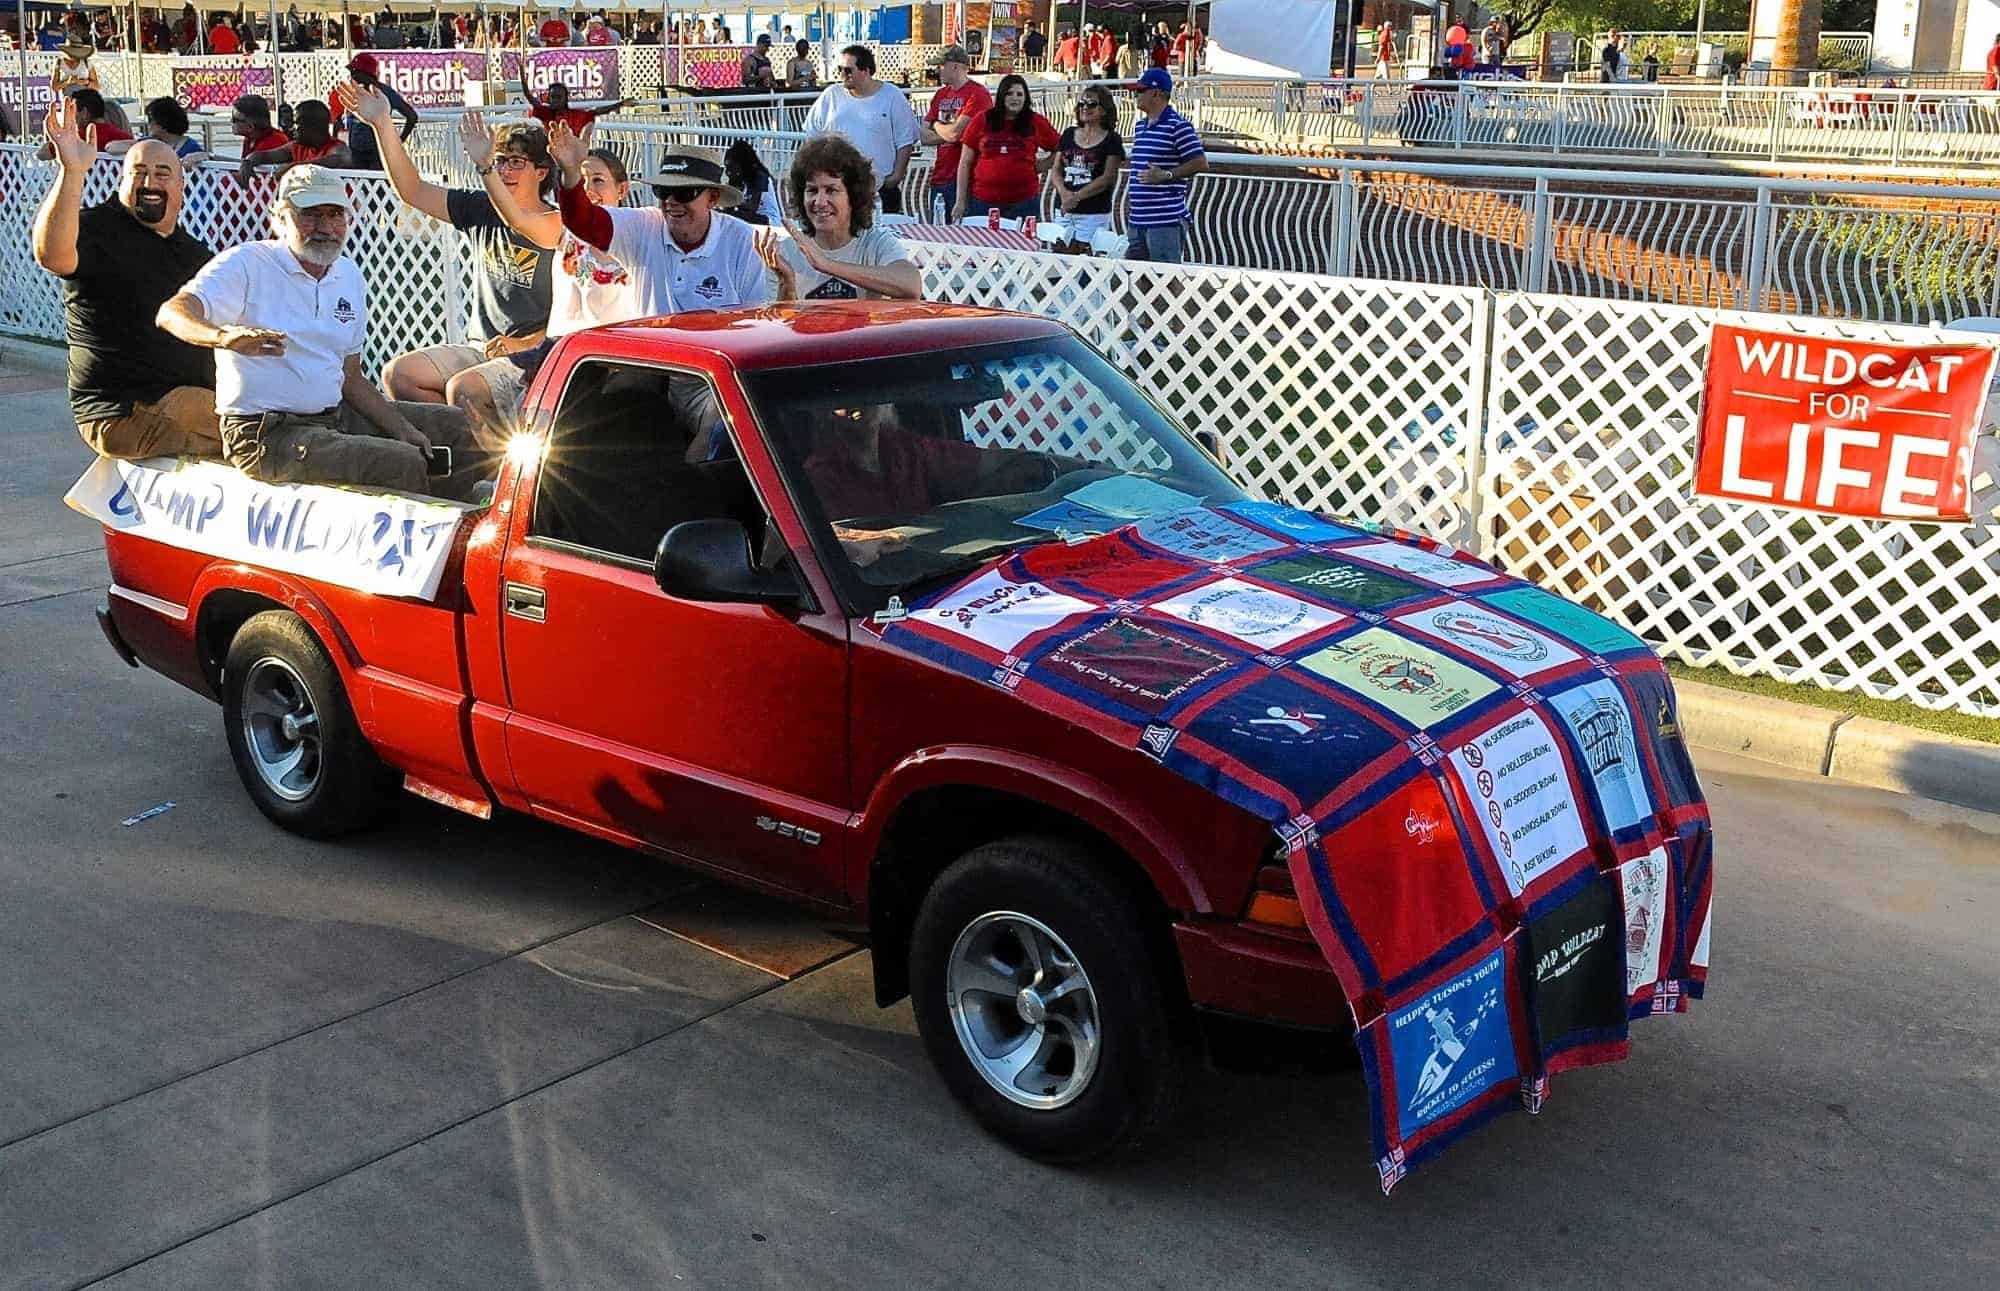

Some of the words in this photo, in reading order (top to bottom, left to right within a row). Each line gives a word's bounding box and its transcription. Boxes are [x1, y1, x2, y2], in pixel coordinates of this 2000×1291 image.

[826, 283, 843, 293] 50
[1735, 335, 1964, 394] WILDCAT
[1809, 392, 1870, 422] FOR
[1720, 414, 1951, 517] LIFE
[1395, 998, 1431, 1029] HELPING
[1431, 975, 1473, 1005] TUCSON'S
[1474, 957, 1500, 982] YOUTH
[1416, 1090, 1446, 1119] ROCKET
[1448, 1082, 1460, 1096] TO
